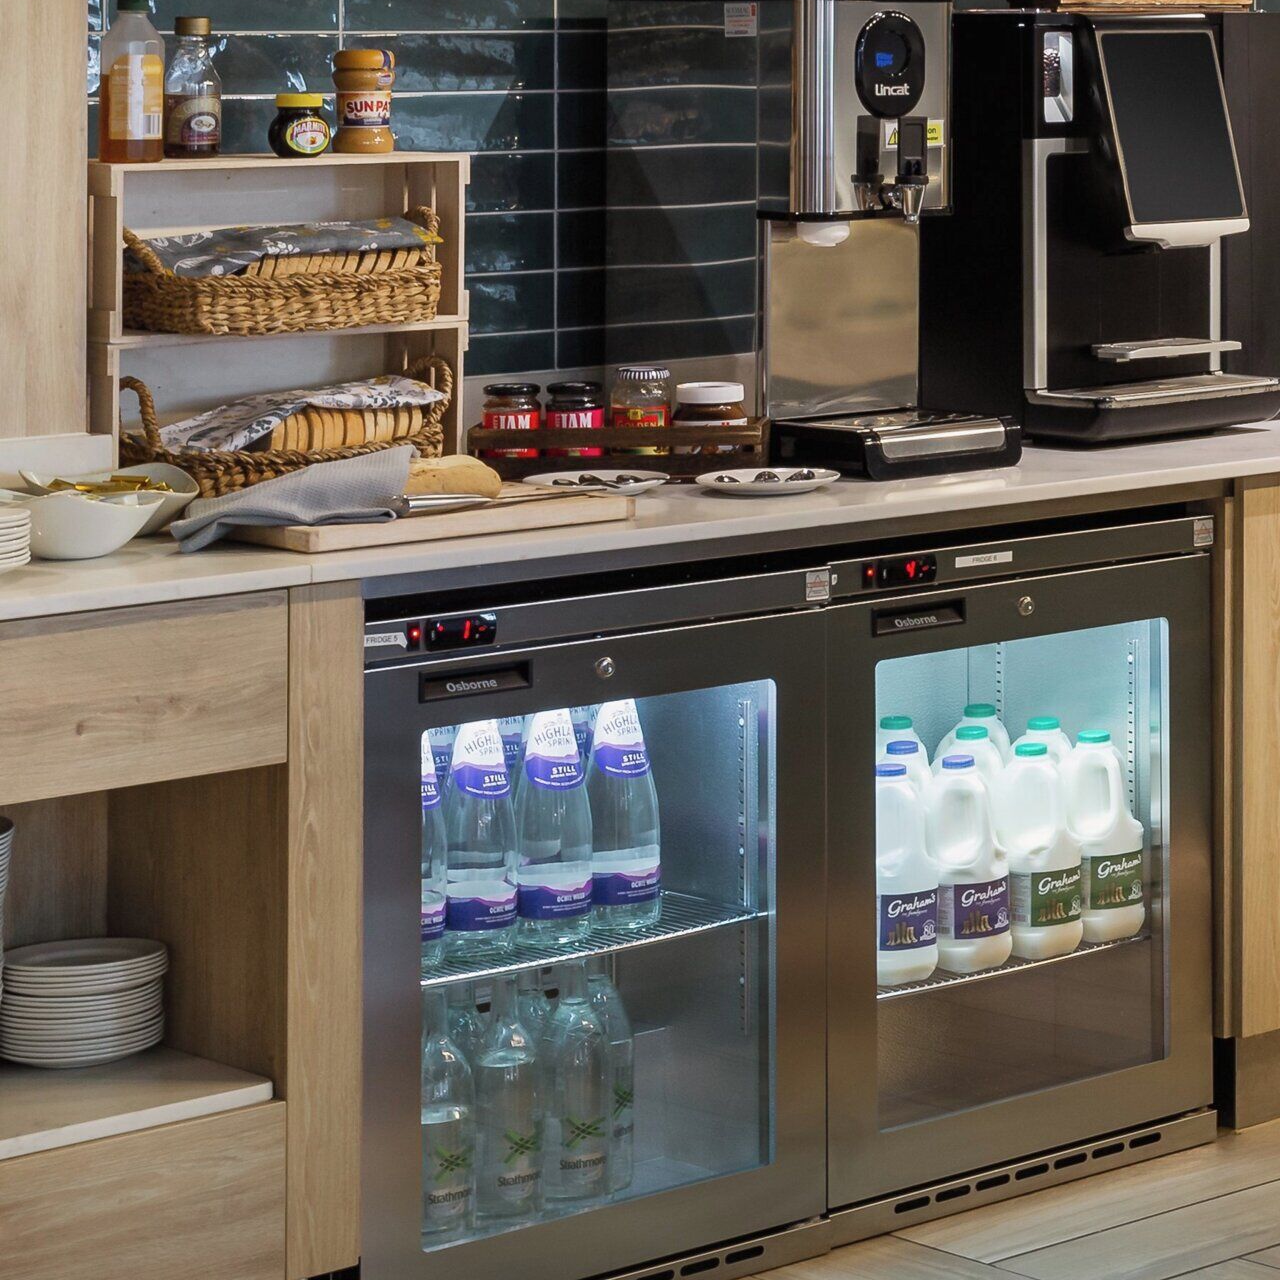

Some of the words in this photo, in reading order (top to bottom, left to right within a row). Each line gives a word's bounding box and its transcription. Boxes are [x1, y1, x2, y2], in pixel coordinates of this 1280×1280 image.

[875, 83, 910, 96] Lincat
[499, 414, 531, 429] JAM
[560, 412, 593, 428] JAM
[971, 556, 992, 564] FRIDGE
[894, 614, 938, 628] Osborne
[365, 635, 393, 644] FRIDGE
[445, 678, 498, 693] Osborne
[603, 714, 637, 735] HIGHL
[464, 735, 500, 755] HIGHL
[547, 737, 573, 748] SPRIN
[622, 753, 645, 763] STILL
[551, 765, 576, 775] STILL
[484, 774, 506, 783] STILL
[420, 784, 436, 793] TILL
[888, 892, 936, 918] Graham's
